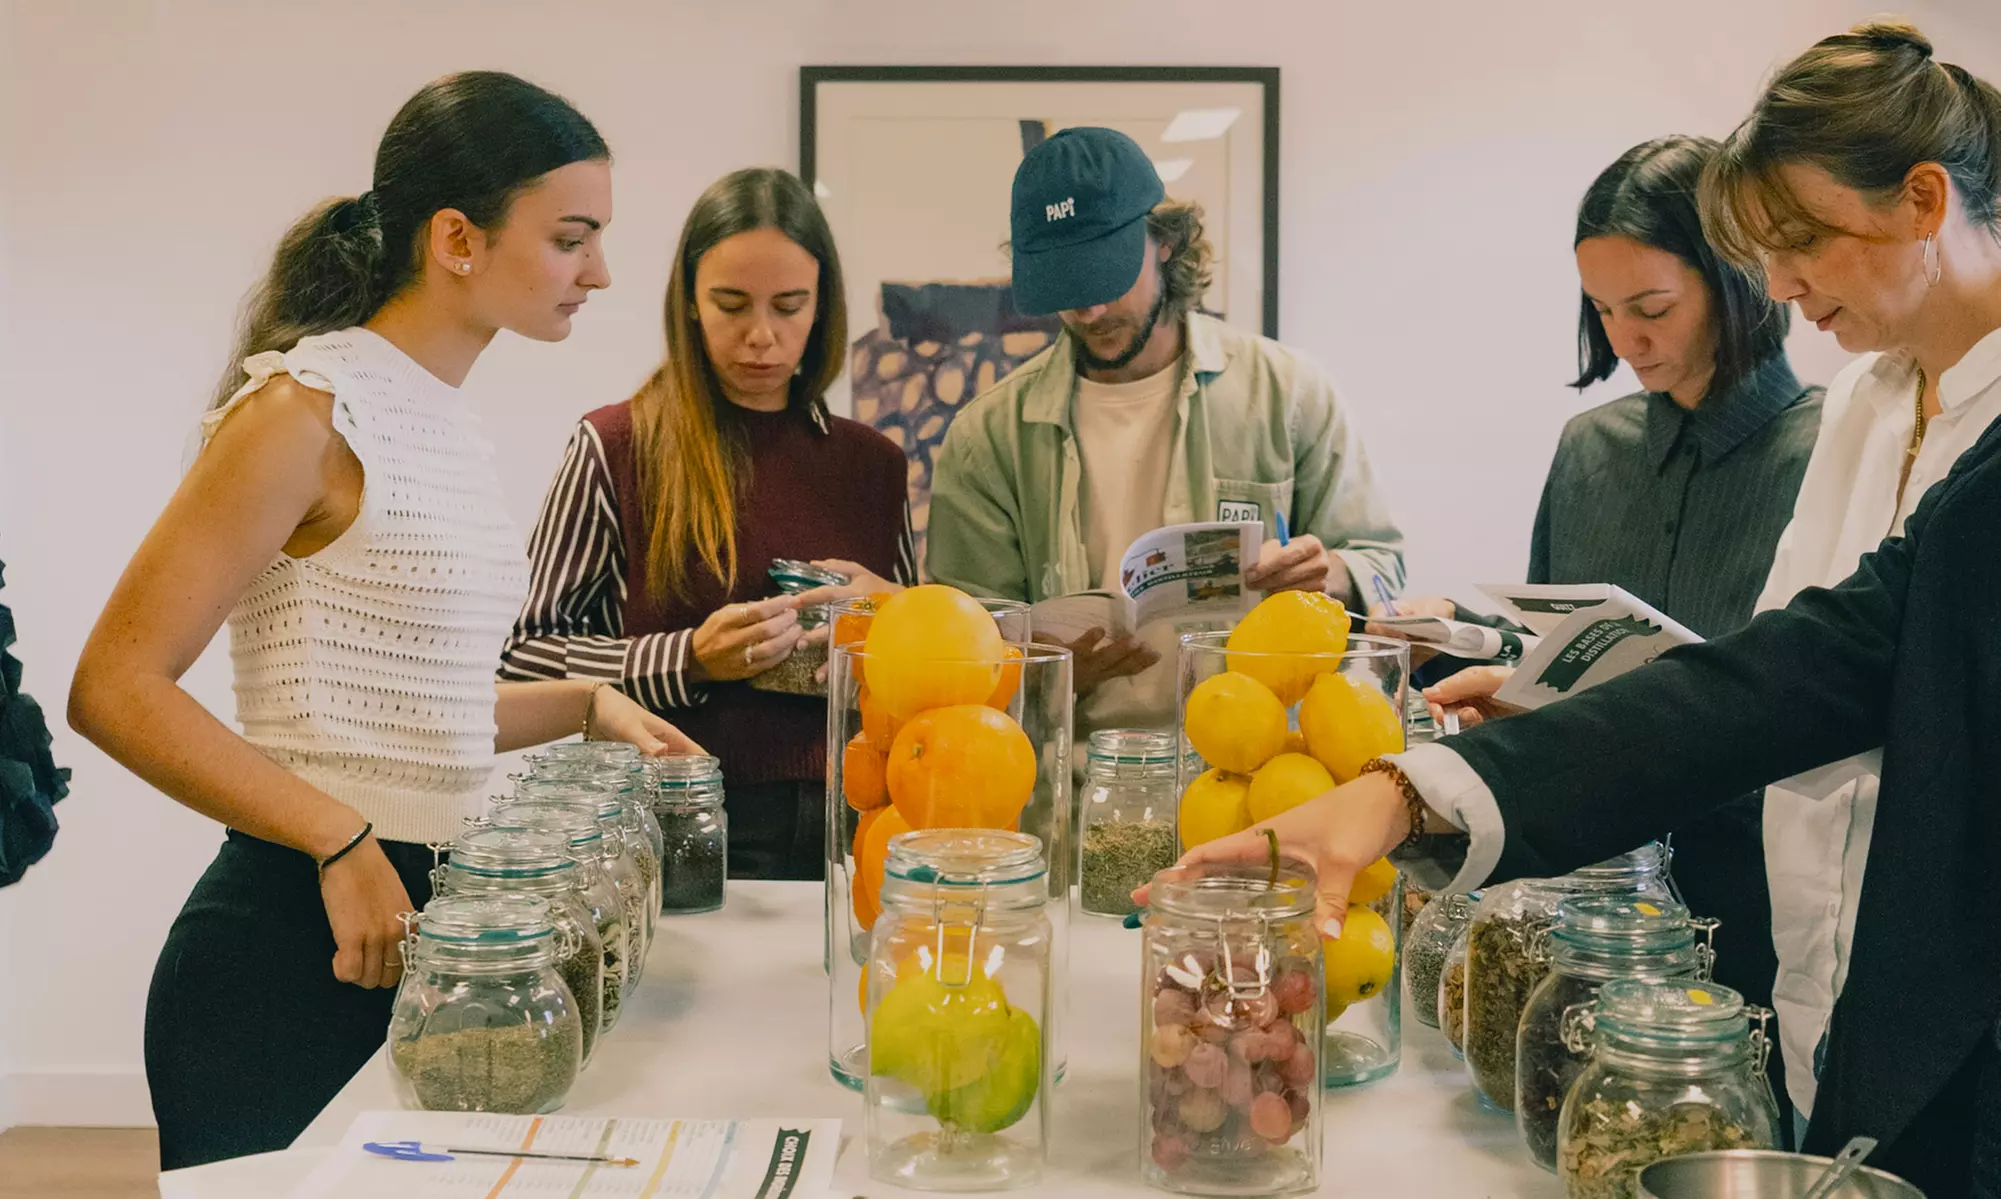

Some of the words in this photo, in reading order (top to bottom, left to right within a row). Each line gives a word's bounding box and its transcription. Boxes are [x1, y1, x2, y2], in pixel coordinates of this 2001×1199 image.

[1562, 650, 1581, 663] LES
[1576, 628, 1603, 650] BASES
[780, 1135, 800, 1162] CHOIX
